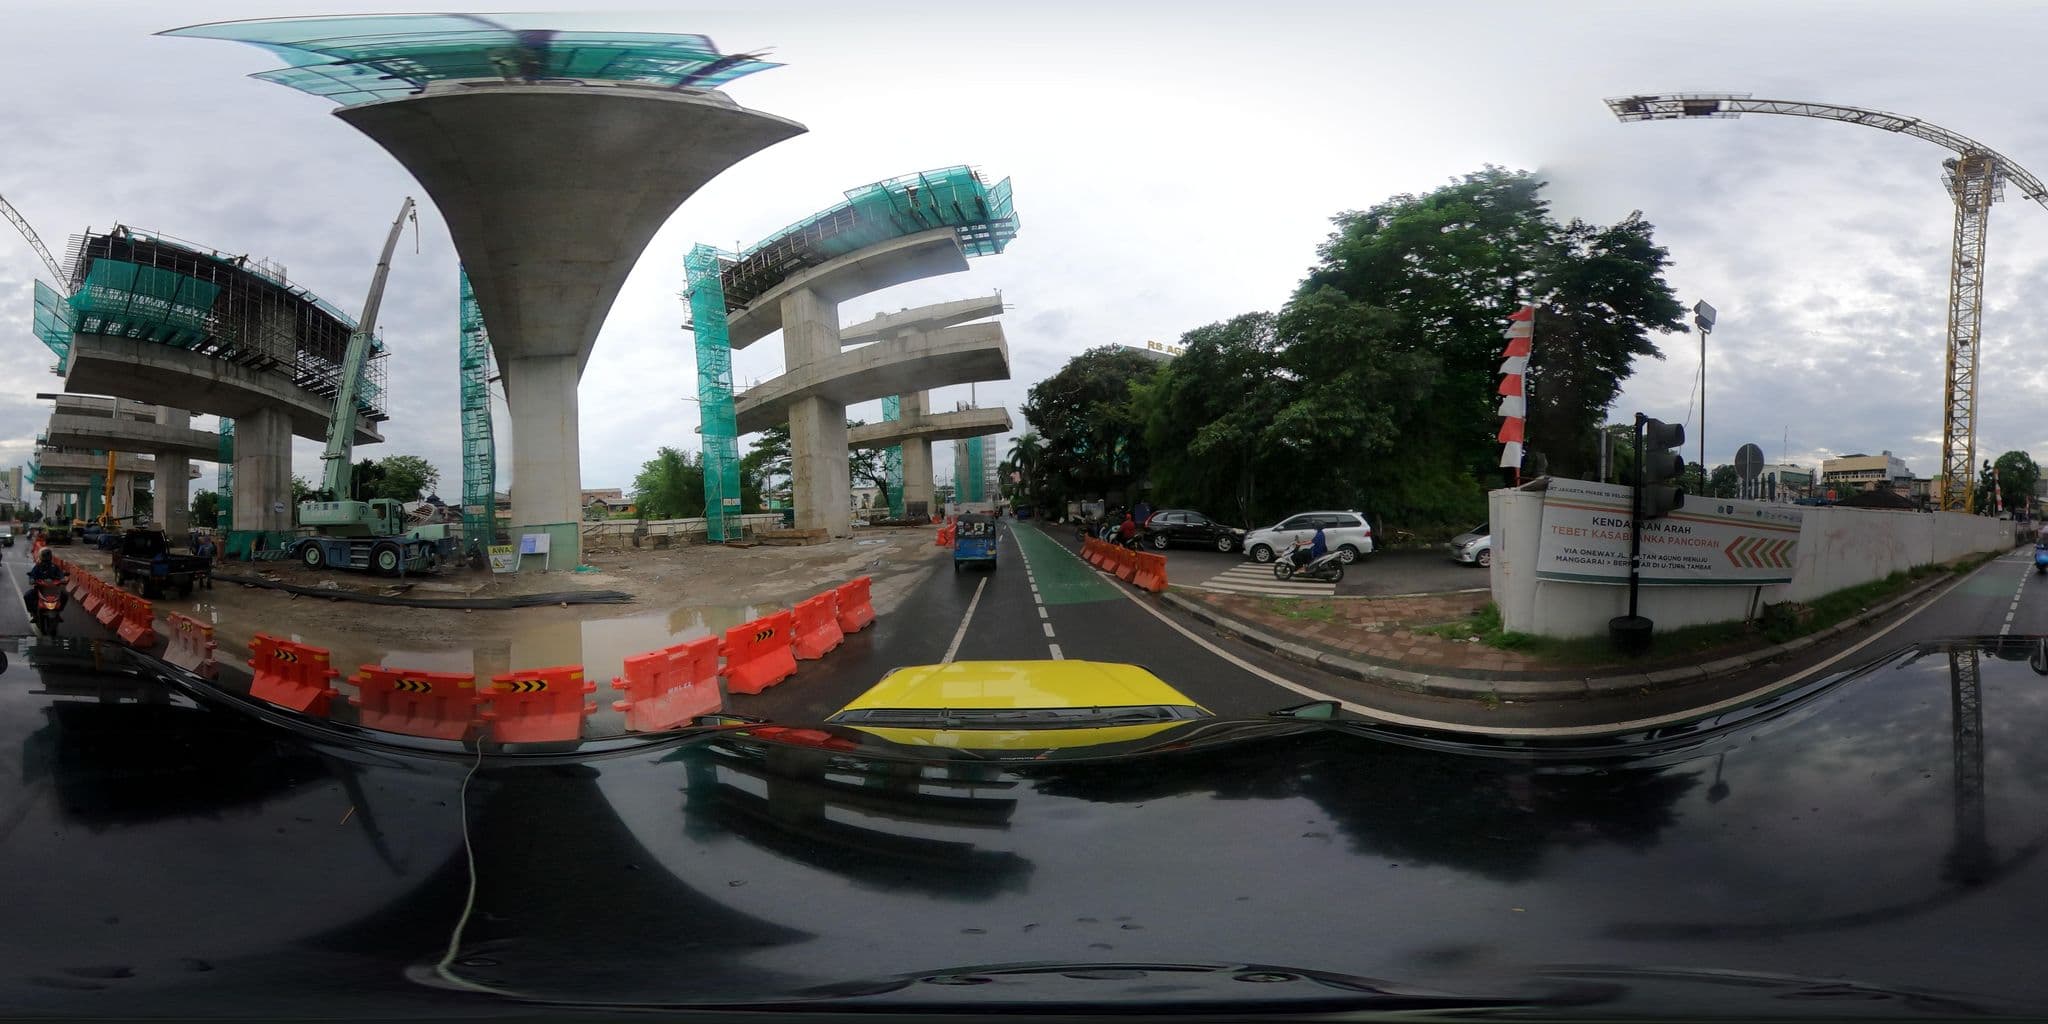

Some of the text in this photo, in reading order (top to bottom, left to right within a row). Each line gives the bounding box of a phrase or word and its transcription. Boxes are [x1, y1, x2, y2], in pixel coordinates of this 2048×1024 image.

[1592, 516, 1692, 534] KENDAAAN ARAH
[1551, 525, 1588, 537] TEBET
[1668, 536, 1720, 548] PANCORAN
[1555, 555, 1605, 565] MANGGARAI
[1613, 559, 1651, 568] BERPTAR
[1563, 547, 1578, 555] VIA
[1580, 549, 1616, 558] ONEWAY
[1629, 552, 1657, 561] SLTAN
